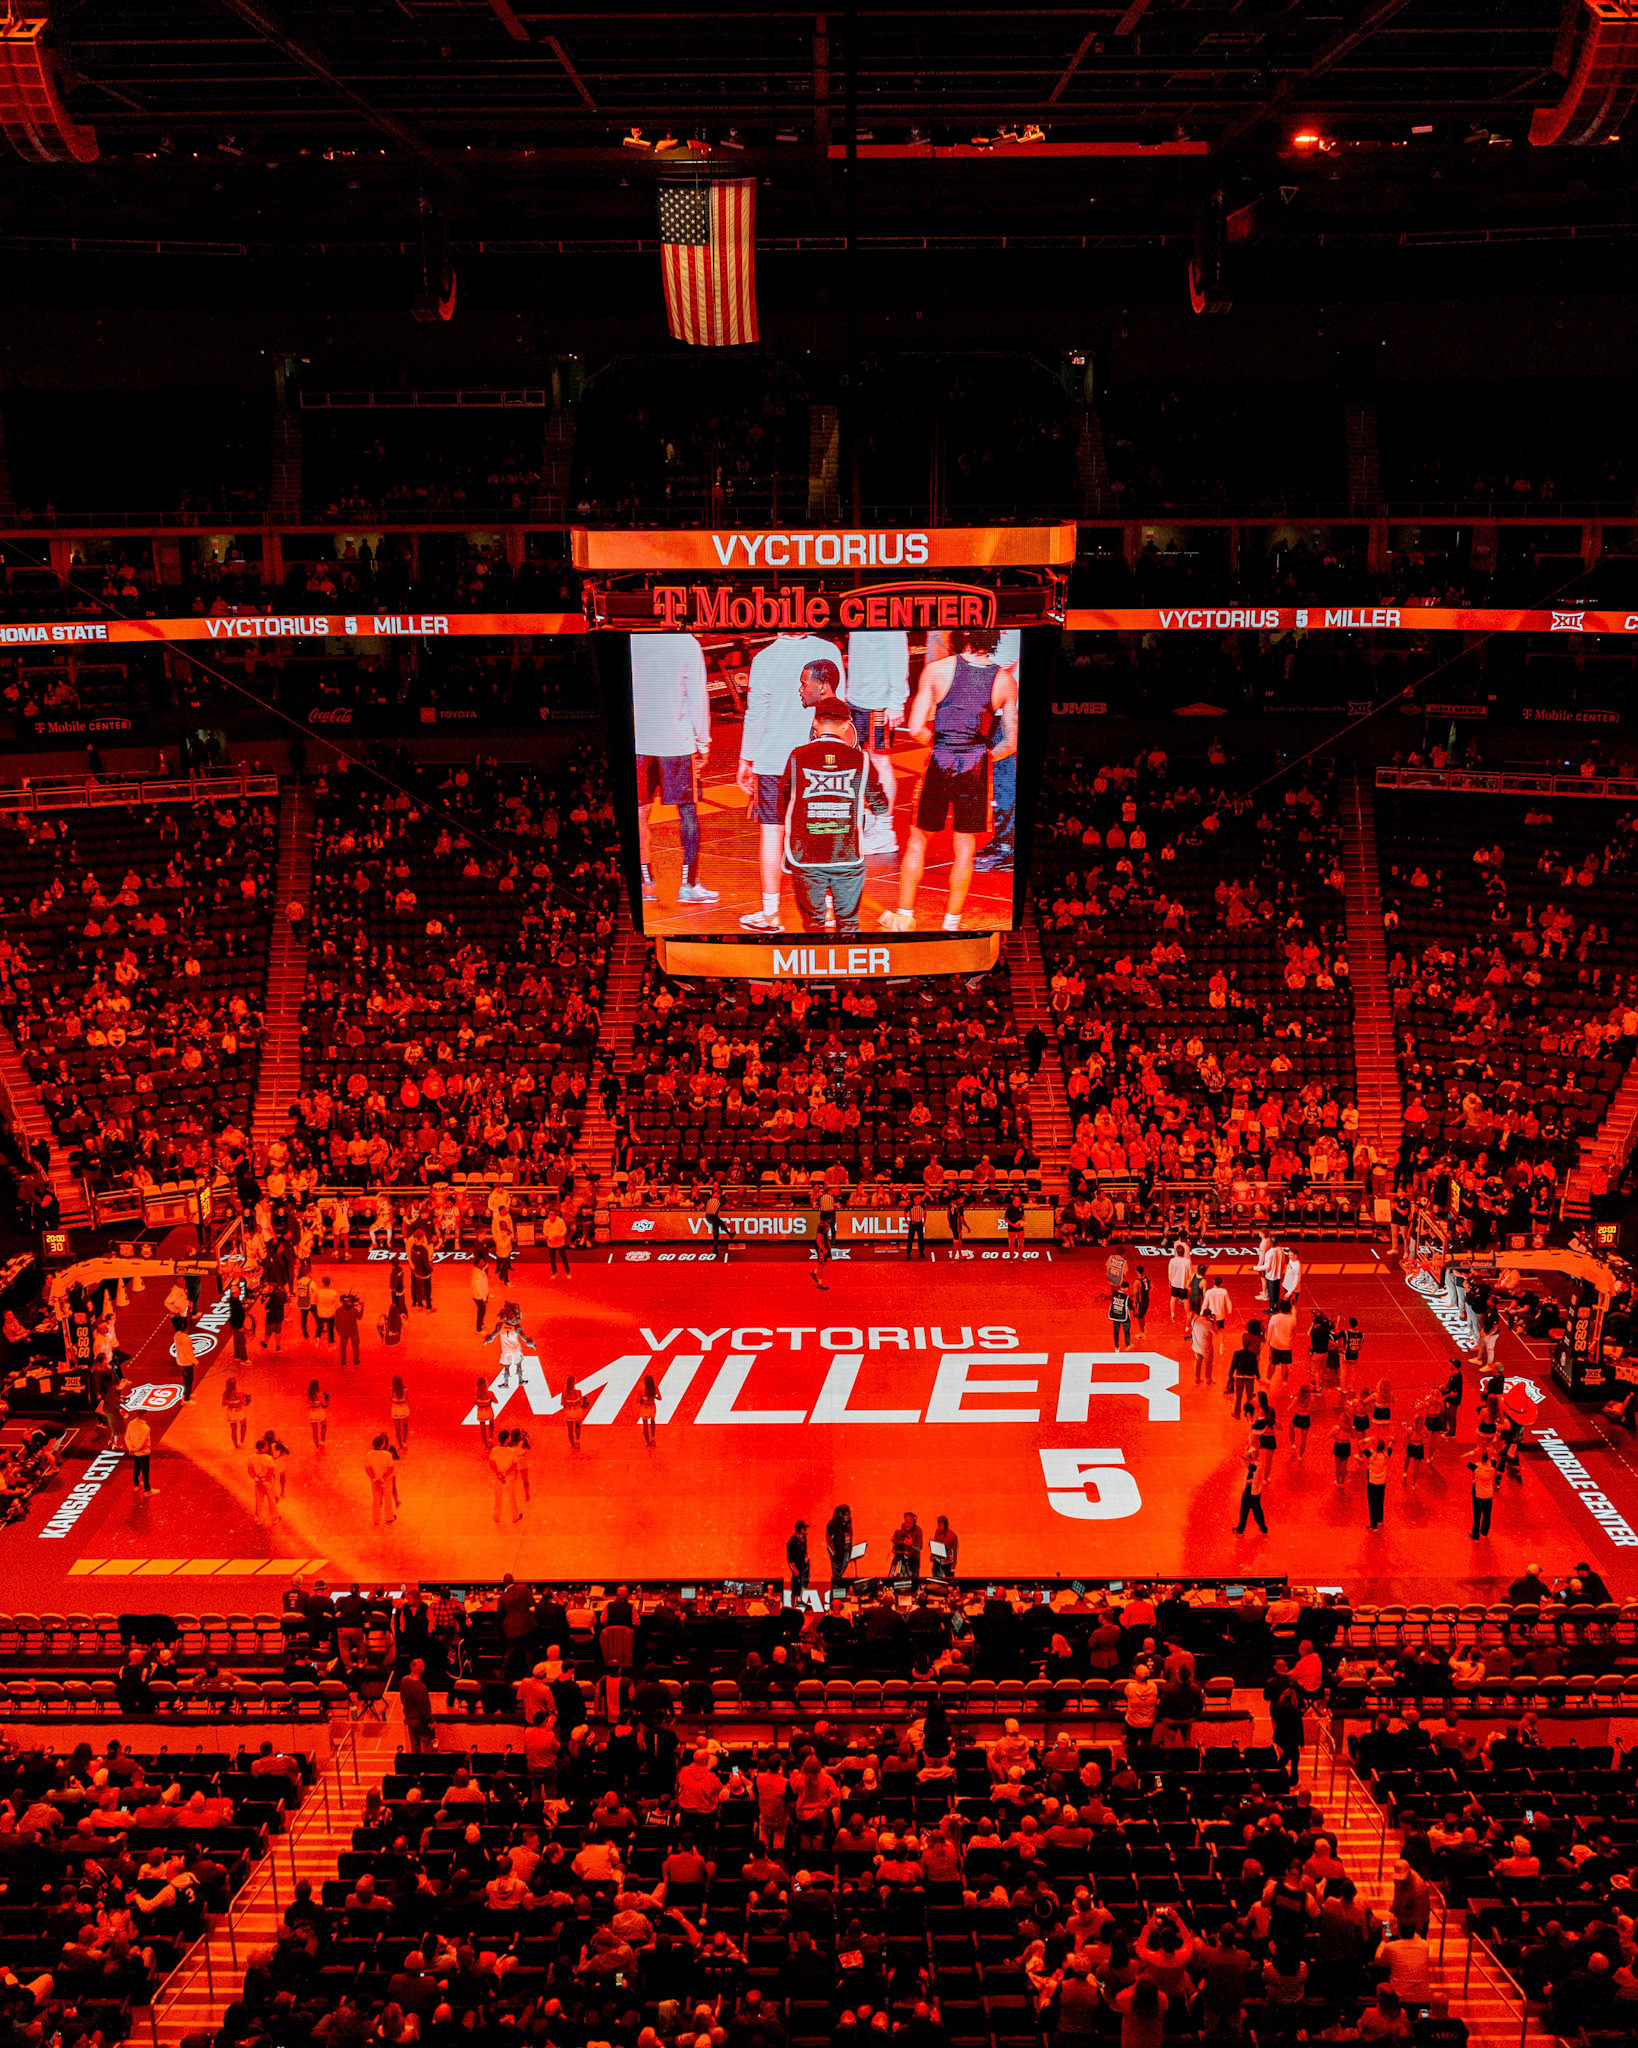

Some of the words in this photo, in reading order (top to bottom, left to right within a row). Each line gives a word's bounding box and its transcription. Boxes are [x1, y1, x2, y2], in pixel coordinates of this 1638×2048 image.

[712, 534, 929, 566] VYCTORIUS
[696, 586, 830, 628] Mobile
[840, 596, 985, 628] CENTER
[1158, 610, 1280, 628] VYCTORIUS
[1295, 609, 1308, 628] 5
[1324, 609, 1401, 627] MILLER
[52, 624, 107, 640] STATE
[205, 617, 329, 637] VYCTORIUS
[344, 616, 358, 634] 5
[373, 616, 449, 635] MILLER
[309, 707, 354, 723] Coca-Cola
[439, 710, 477, 719] TOYOTA
[1051, 702, 1107, 715] UMB
[1535, 709, 1573, 721] Mobile
[1576, 713, 1616, 722] CENTER
[47, 719, 86, 733] Mobile
[89, 721, 128, 731] CENTER
[772, 948, 890, 975] MILLER
[851, 1217, 926, 1234] MILLE
[1598, 1225, 1617, 1234] 20:00
[46, 1234, 65, 1242] 20:00
[1600, 1233, 1613, 1243] 30
[50, 1242, 63, 1252] 30
[658, 1253, 676, 1261] GO
[678, 1253, 697, 1261] GO
[698, 1253, 717, 1261] GO
[981, 1251, 999, 1259] GO
[1022, 1251, 1039, 1259] GO
[76, 1326, 88, 1337] GO
[1575, 1319, 1589, 1330] GO
[77, 1336, 90, 1347] GO
[639, 1326, 1019, 1351] VYCTORIUS
[1574, 1329, 1587, 1340] GO
[77, 1346, 90, 1358] GO
[1574, 1340, 1587, 1351] GO
[462, 1352, 1180, 1426] MILLER
[147, 1389, 173, 1406] 66
[1038, 1448, 1142, 1520] 5
[1531, 1428, 1599, 1489] T-MOBILE
[1578, 1491, 1638, 1546] CENTER
[38, 1483, 102, 1538] KANSAS
[82, 1450, 125, 1481] CITY
[185, 1887, 196, 1904] 3
